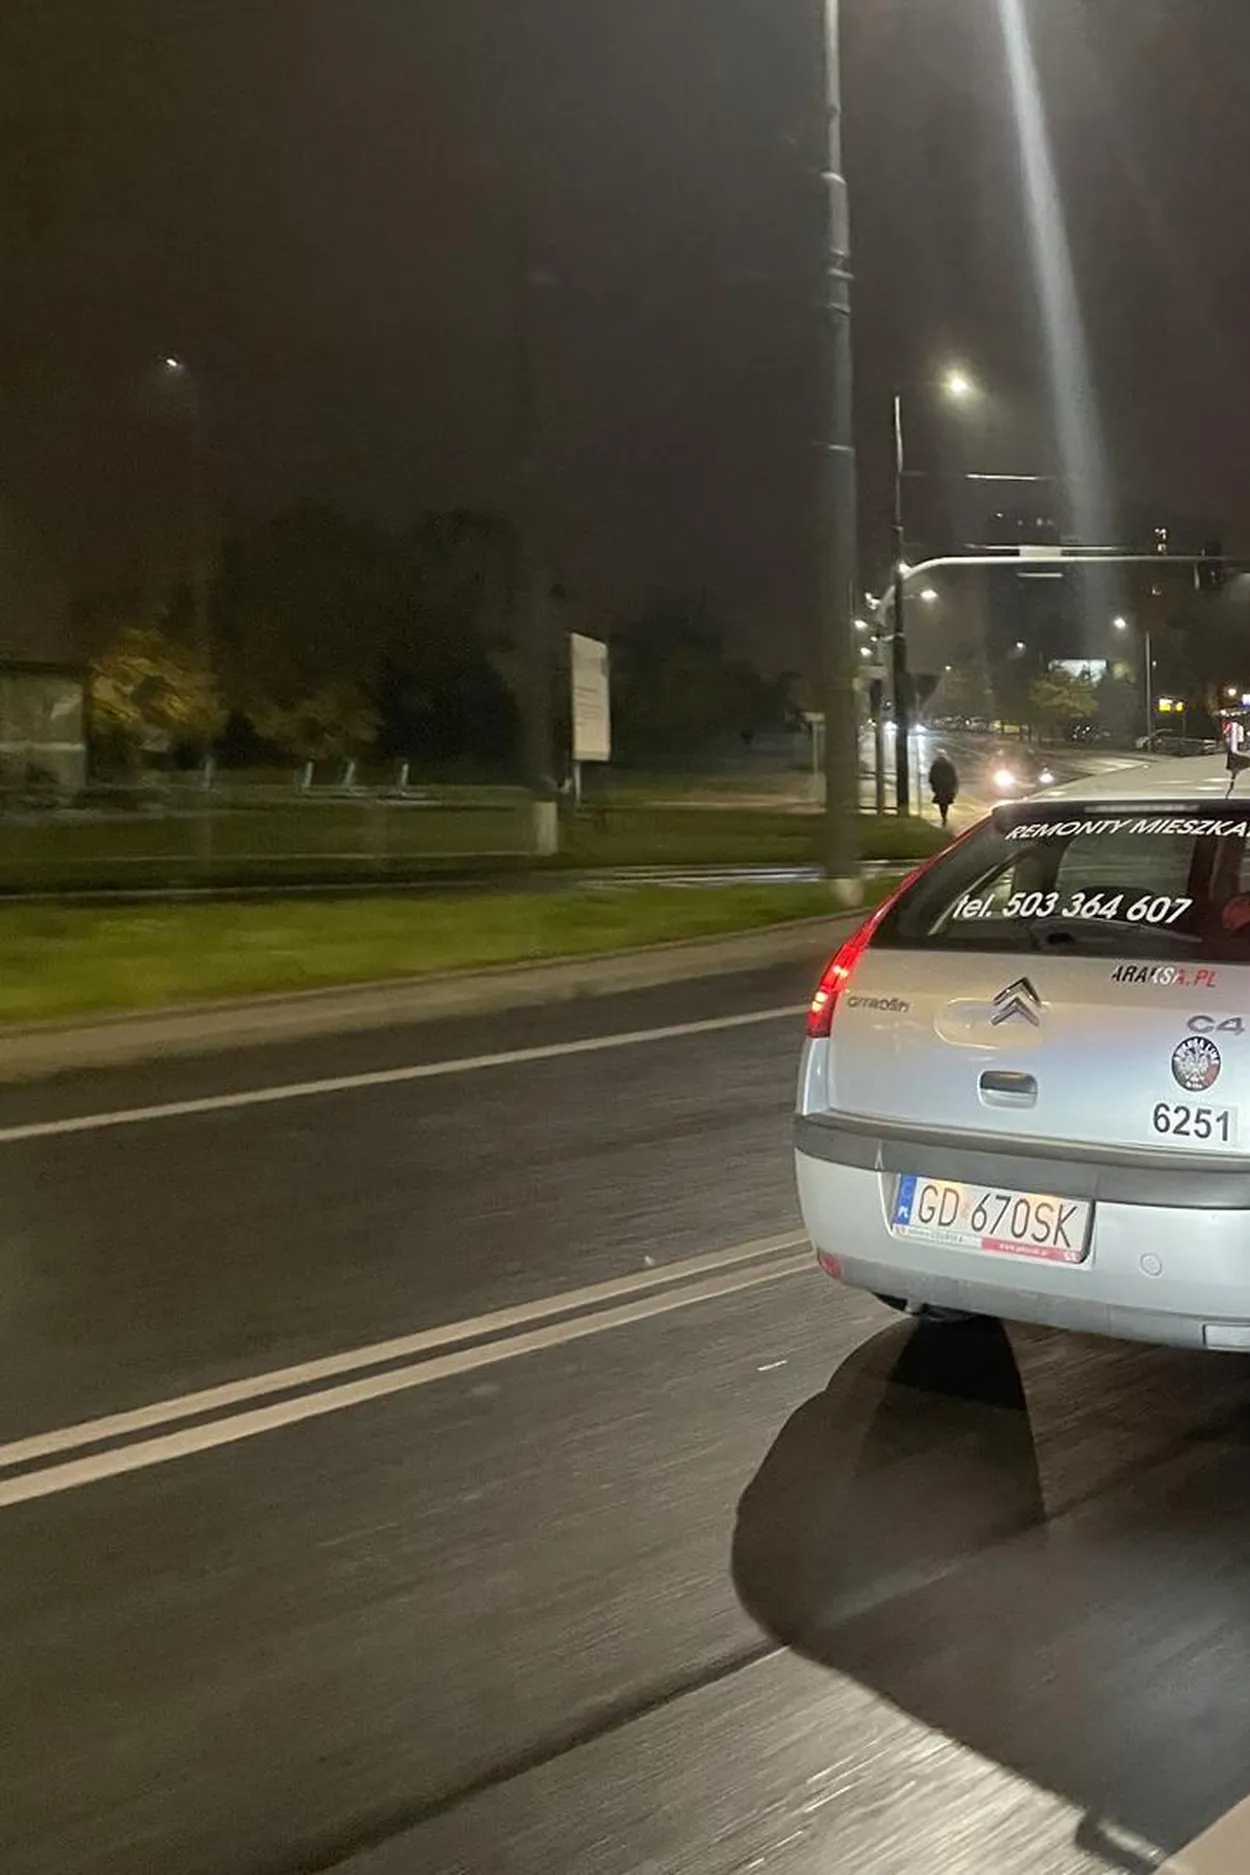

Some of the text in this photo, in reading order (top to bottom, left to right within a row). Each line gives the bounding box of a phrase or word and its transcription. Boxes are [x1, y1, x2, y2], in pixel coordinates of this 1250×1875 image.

[1005, 819, 1131, 840] REMONTY
[952, 892, 1193, 923] tel. 503 364 607
[1186, 1014, 1245, 1035] C4
[1153, 1102, 1229, 1141] 6251
[917, 1184, 1078, 1248] GD 670SK
